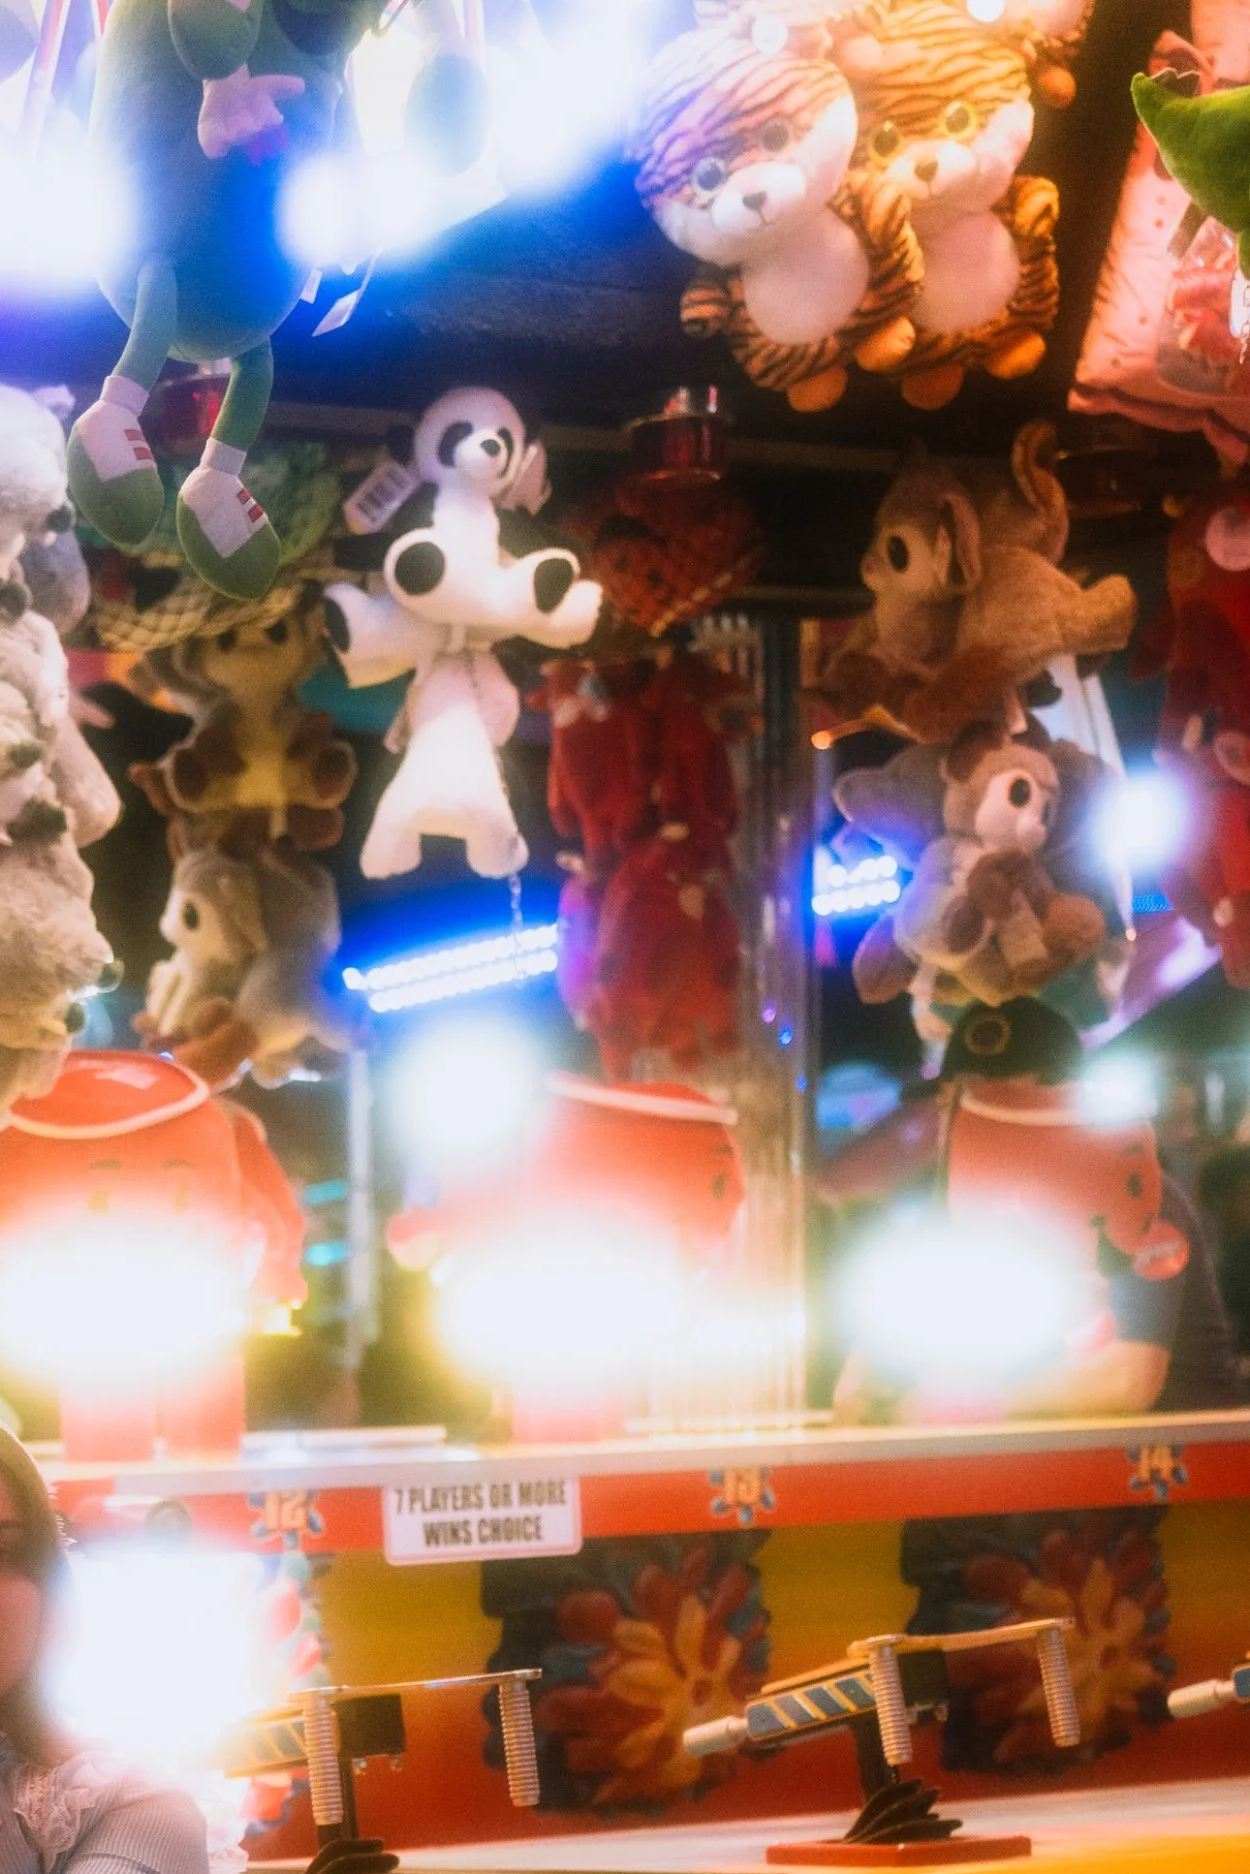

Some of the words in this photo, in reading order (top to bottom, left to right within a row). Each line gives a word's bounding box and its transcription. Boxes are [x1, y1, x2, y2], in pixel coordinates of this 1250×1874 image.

[409, 1482, 484, 1513] PLAYERS
[489, 1483, 512, 1509] OR
[518, 1479, 566, 1507] MORE
[423, 1519, 472, 1547] WINS
[477, 1515, 543, 1543] CHOICE
